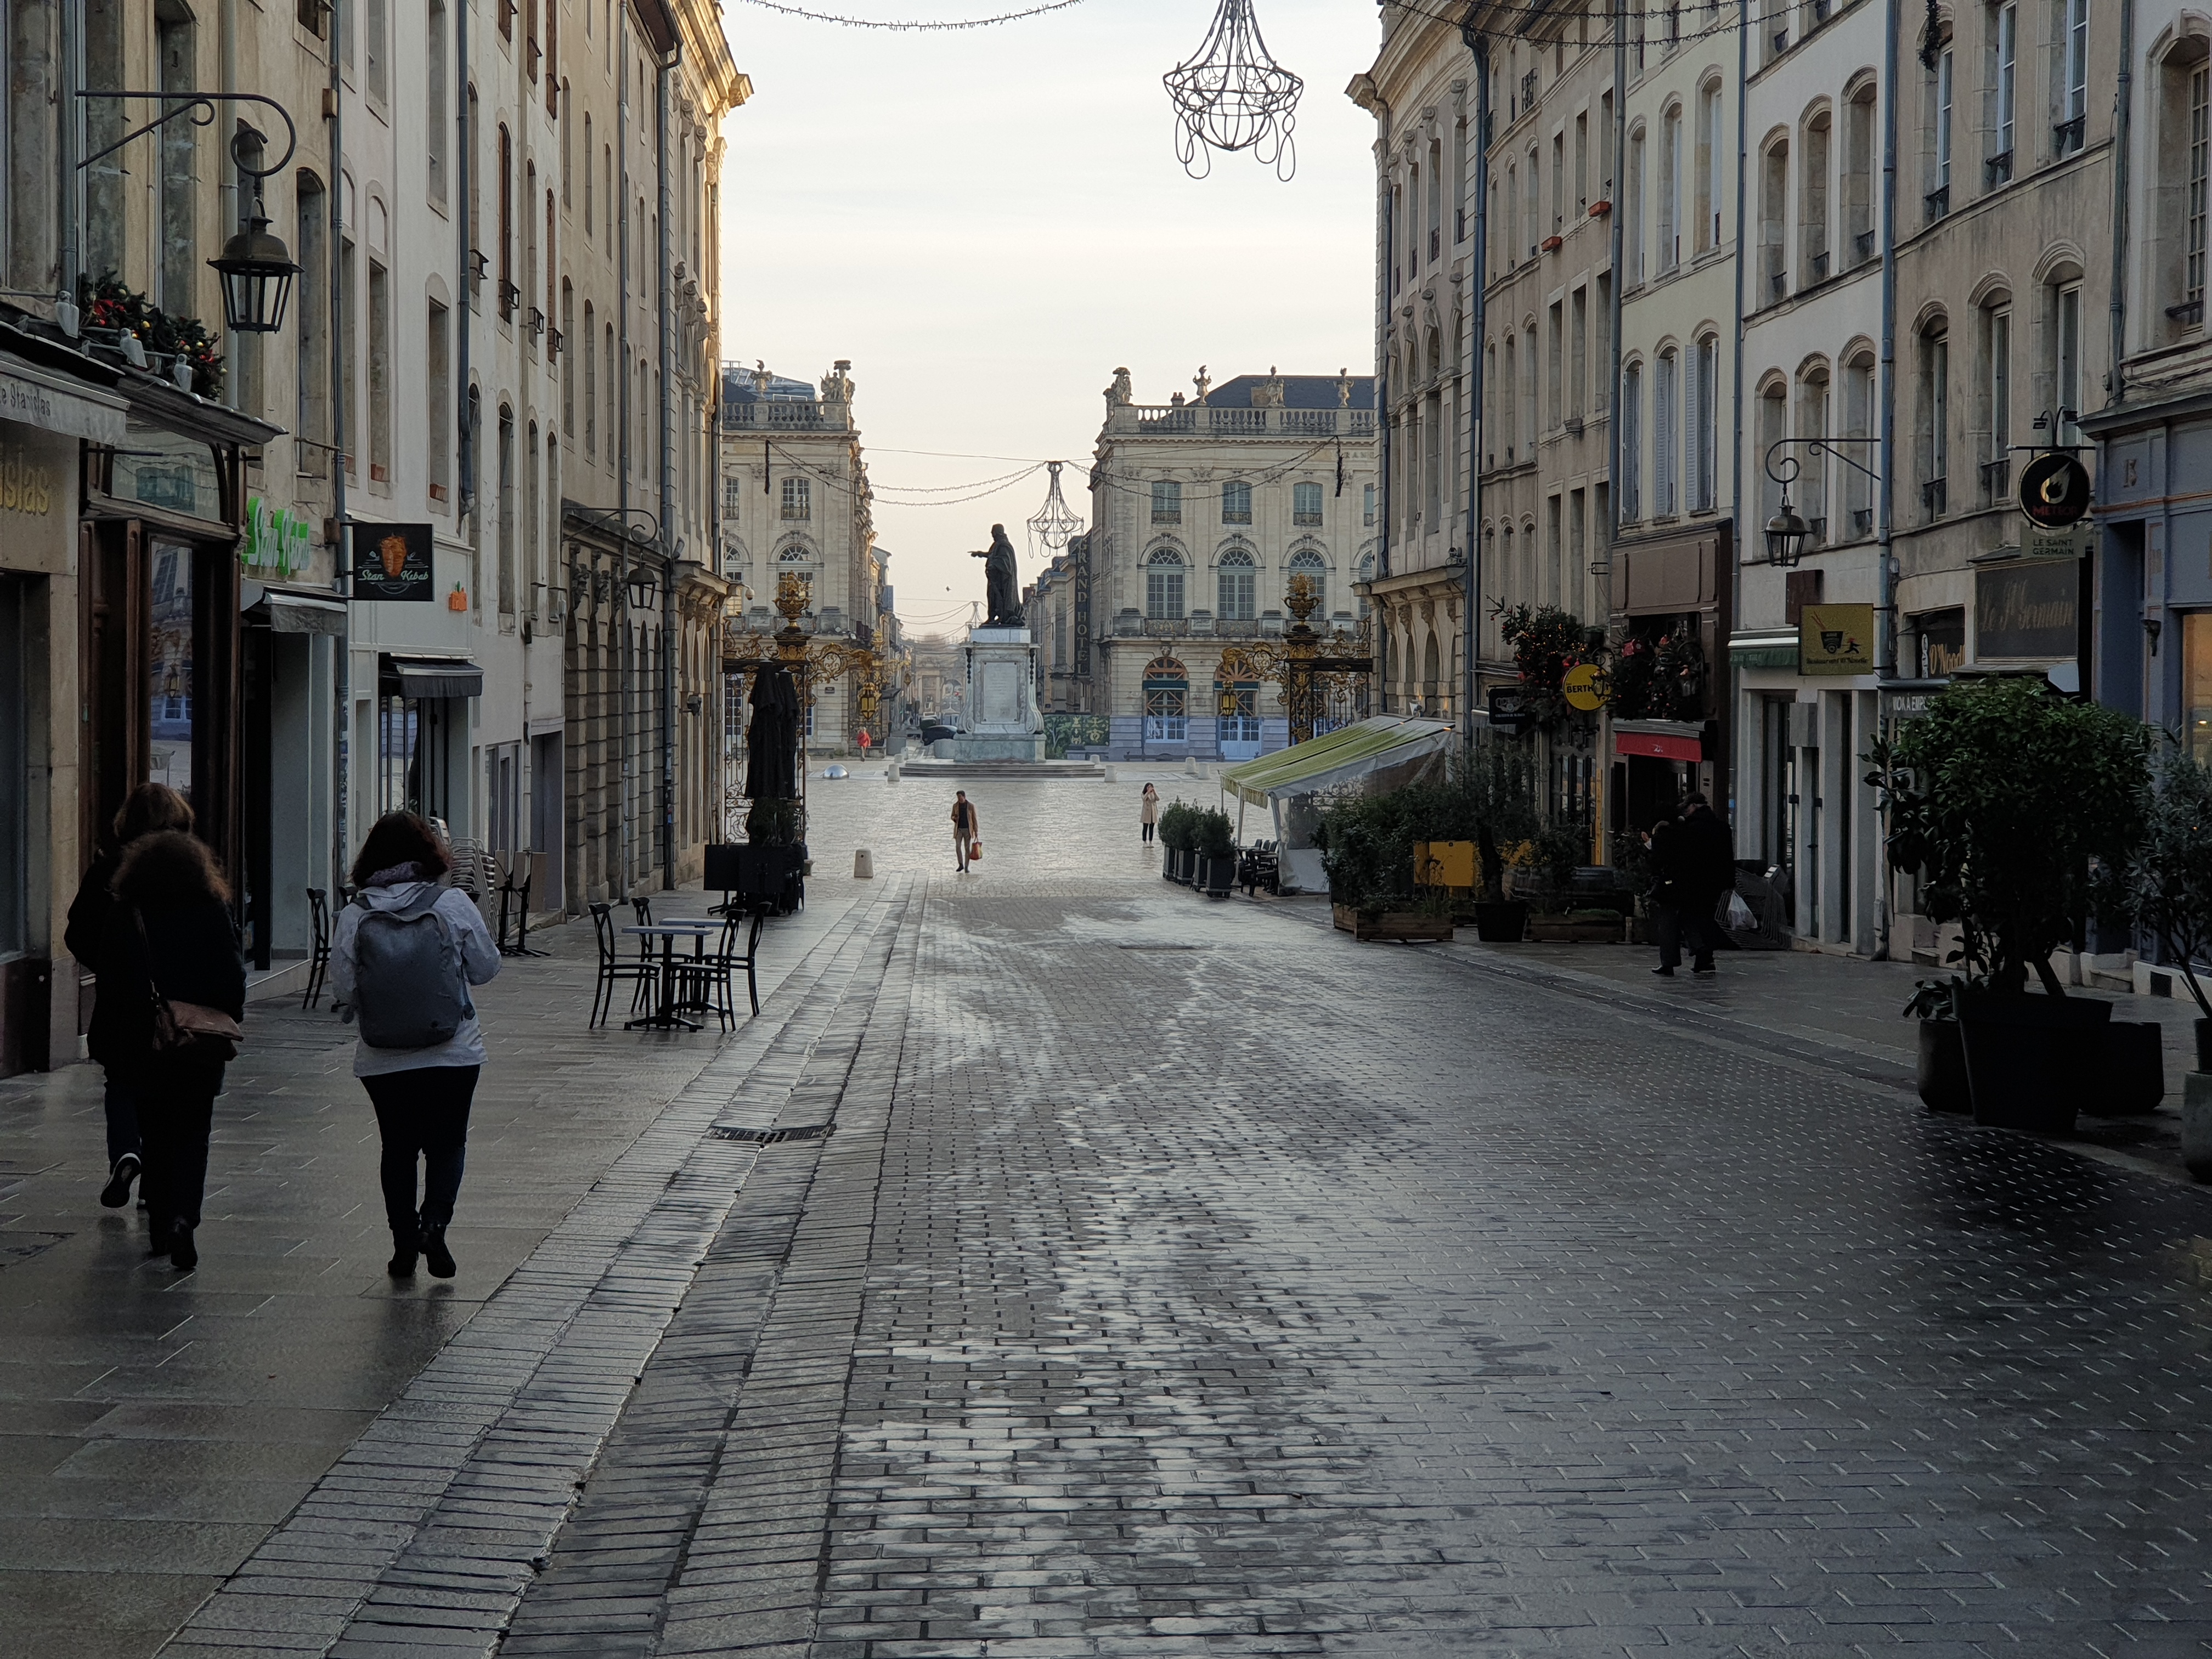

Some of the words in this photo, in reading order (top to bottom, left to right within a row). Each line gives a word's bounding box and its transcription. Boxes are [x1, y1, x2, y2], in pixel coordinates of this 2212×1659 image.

[10, 383, 51, 416] Stanislas
[358, 569, 385, 580] Stan
[400, 570, 428, 581] Kebab
[1077, 540, 1088, 602] GRAND
[1077, 611, 1088, 674] HOTEL
